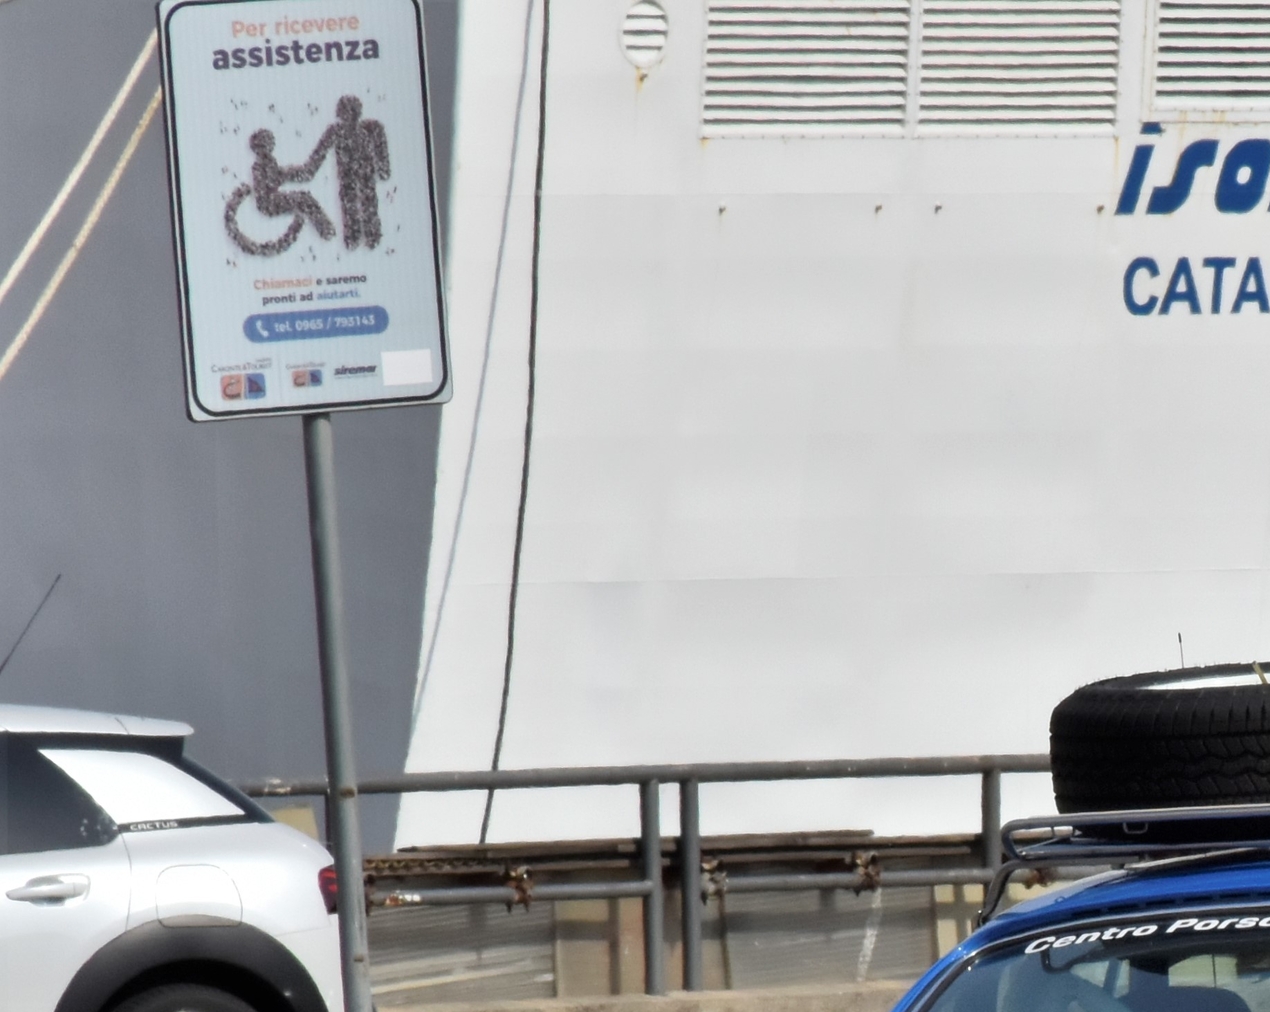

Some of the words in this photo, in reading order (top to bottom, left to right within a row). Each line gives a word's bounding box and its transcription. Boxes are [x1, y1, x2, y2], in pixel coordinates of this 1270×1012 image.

[231, 20, 267, 38] Per
[274, 15, 360, 35] ricevere
[212, 38, 380, 70] assistenza
[253, 276, 313, 290] Chiamaci
[316, 278, 323, 286] e
[325, 274, 367, 285] saremo
[262, 293, 297, 306] pronti
[299, 291, 314, 302] ad
[295, 318, 323, 331] 0965
[334, 365, 377, 375] siremar
[130, 821, 178, 831] CACTUS
[1024, 923, 1157, 954] Centro
